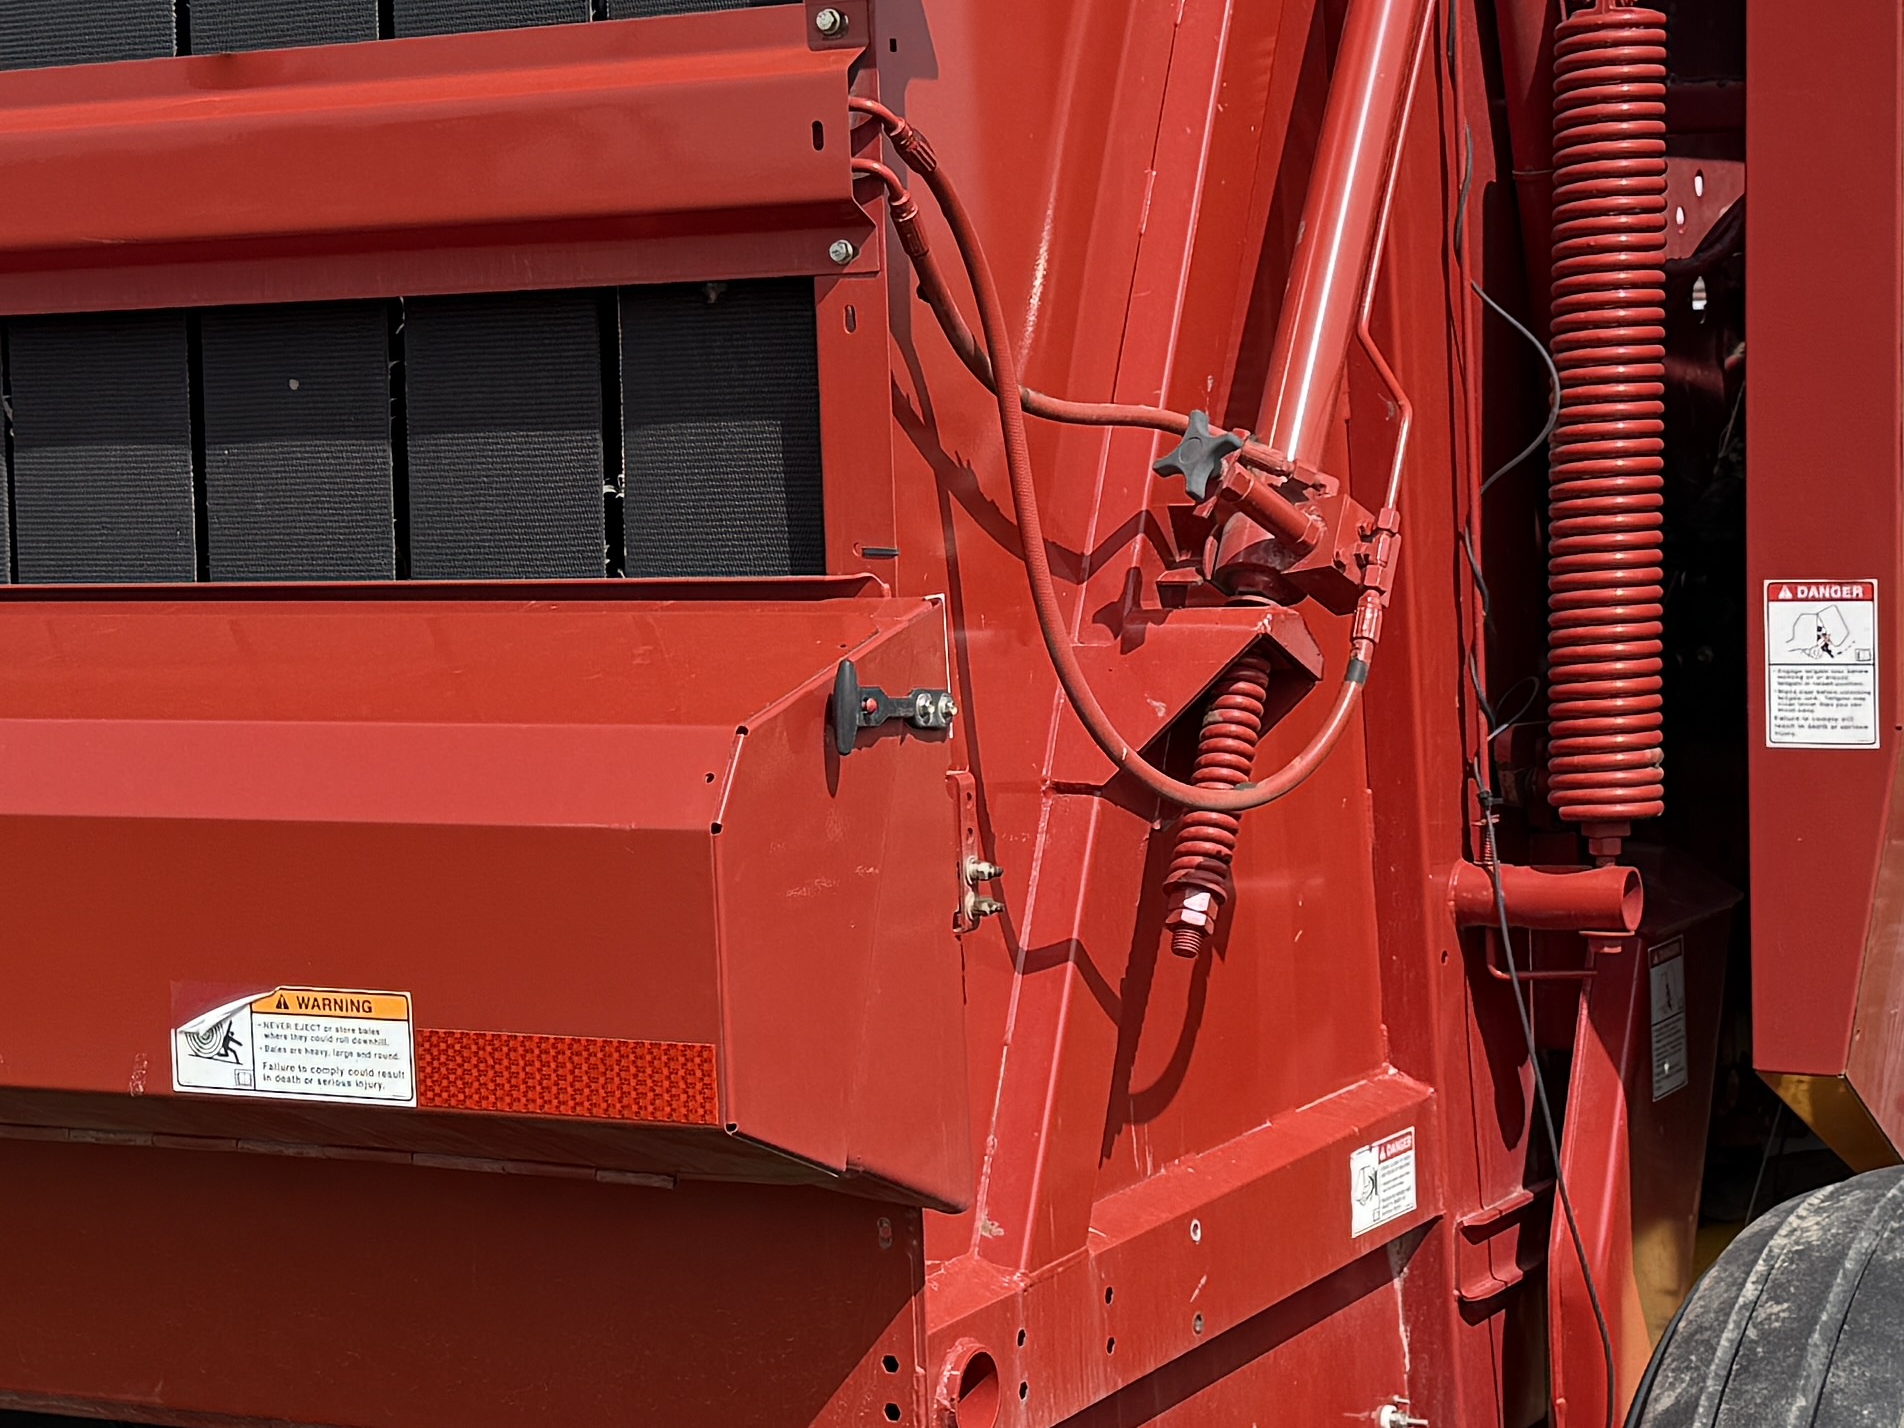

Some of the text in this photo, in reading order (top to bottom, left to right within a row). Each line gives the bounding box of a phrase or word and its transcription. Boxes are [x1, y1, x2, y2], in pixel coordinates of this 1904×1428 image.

[1797, 585, 1864, 599] DANGER
[296, 995, 373, 1013] WARNING
[263, 1021, 291, 1030] NEVER
[294, 1023, 320, 1031] EJECT
[264, 1032, 287, 1040] where
[290, 1033, 307, 1043] they
[310, 1035, 333, 1043] could
[263, 1062, 405, 1079] Failure to comply could result
[263, 1073, 272, 1082] in
[275, 1074, 301, 1084] death
